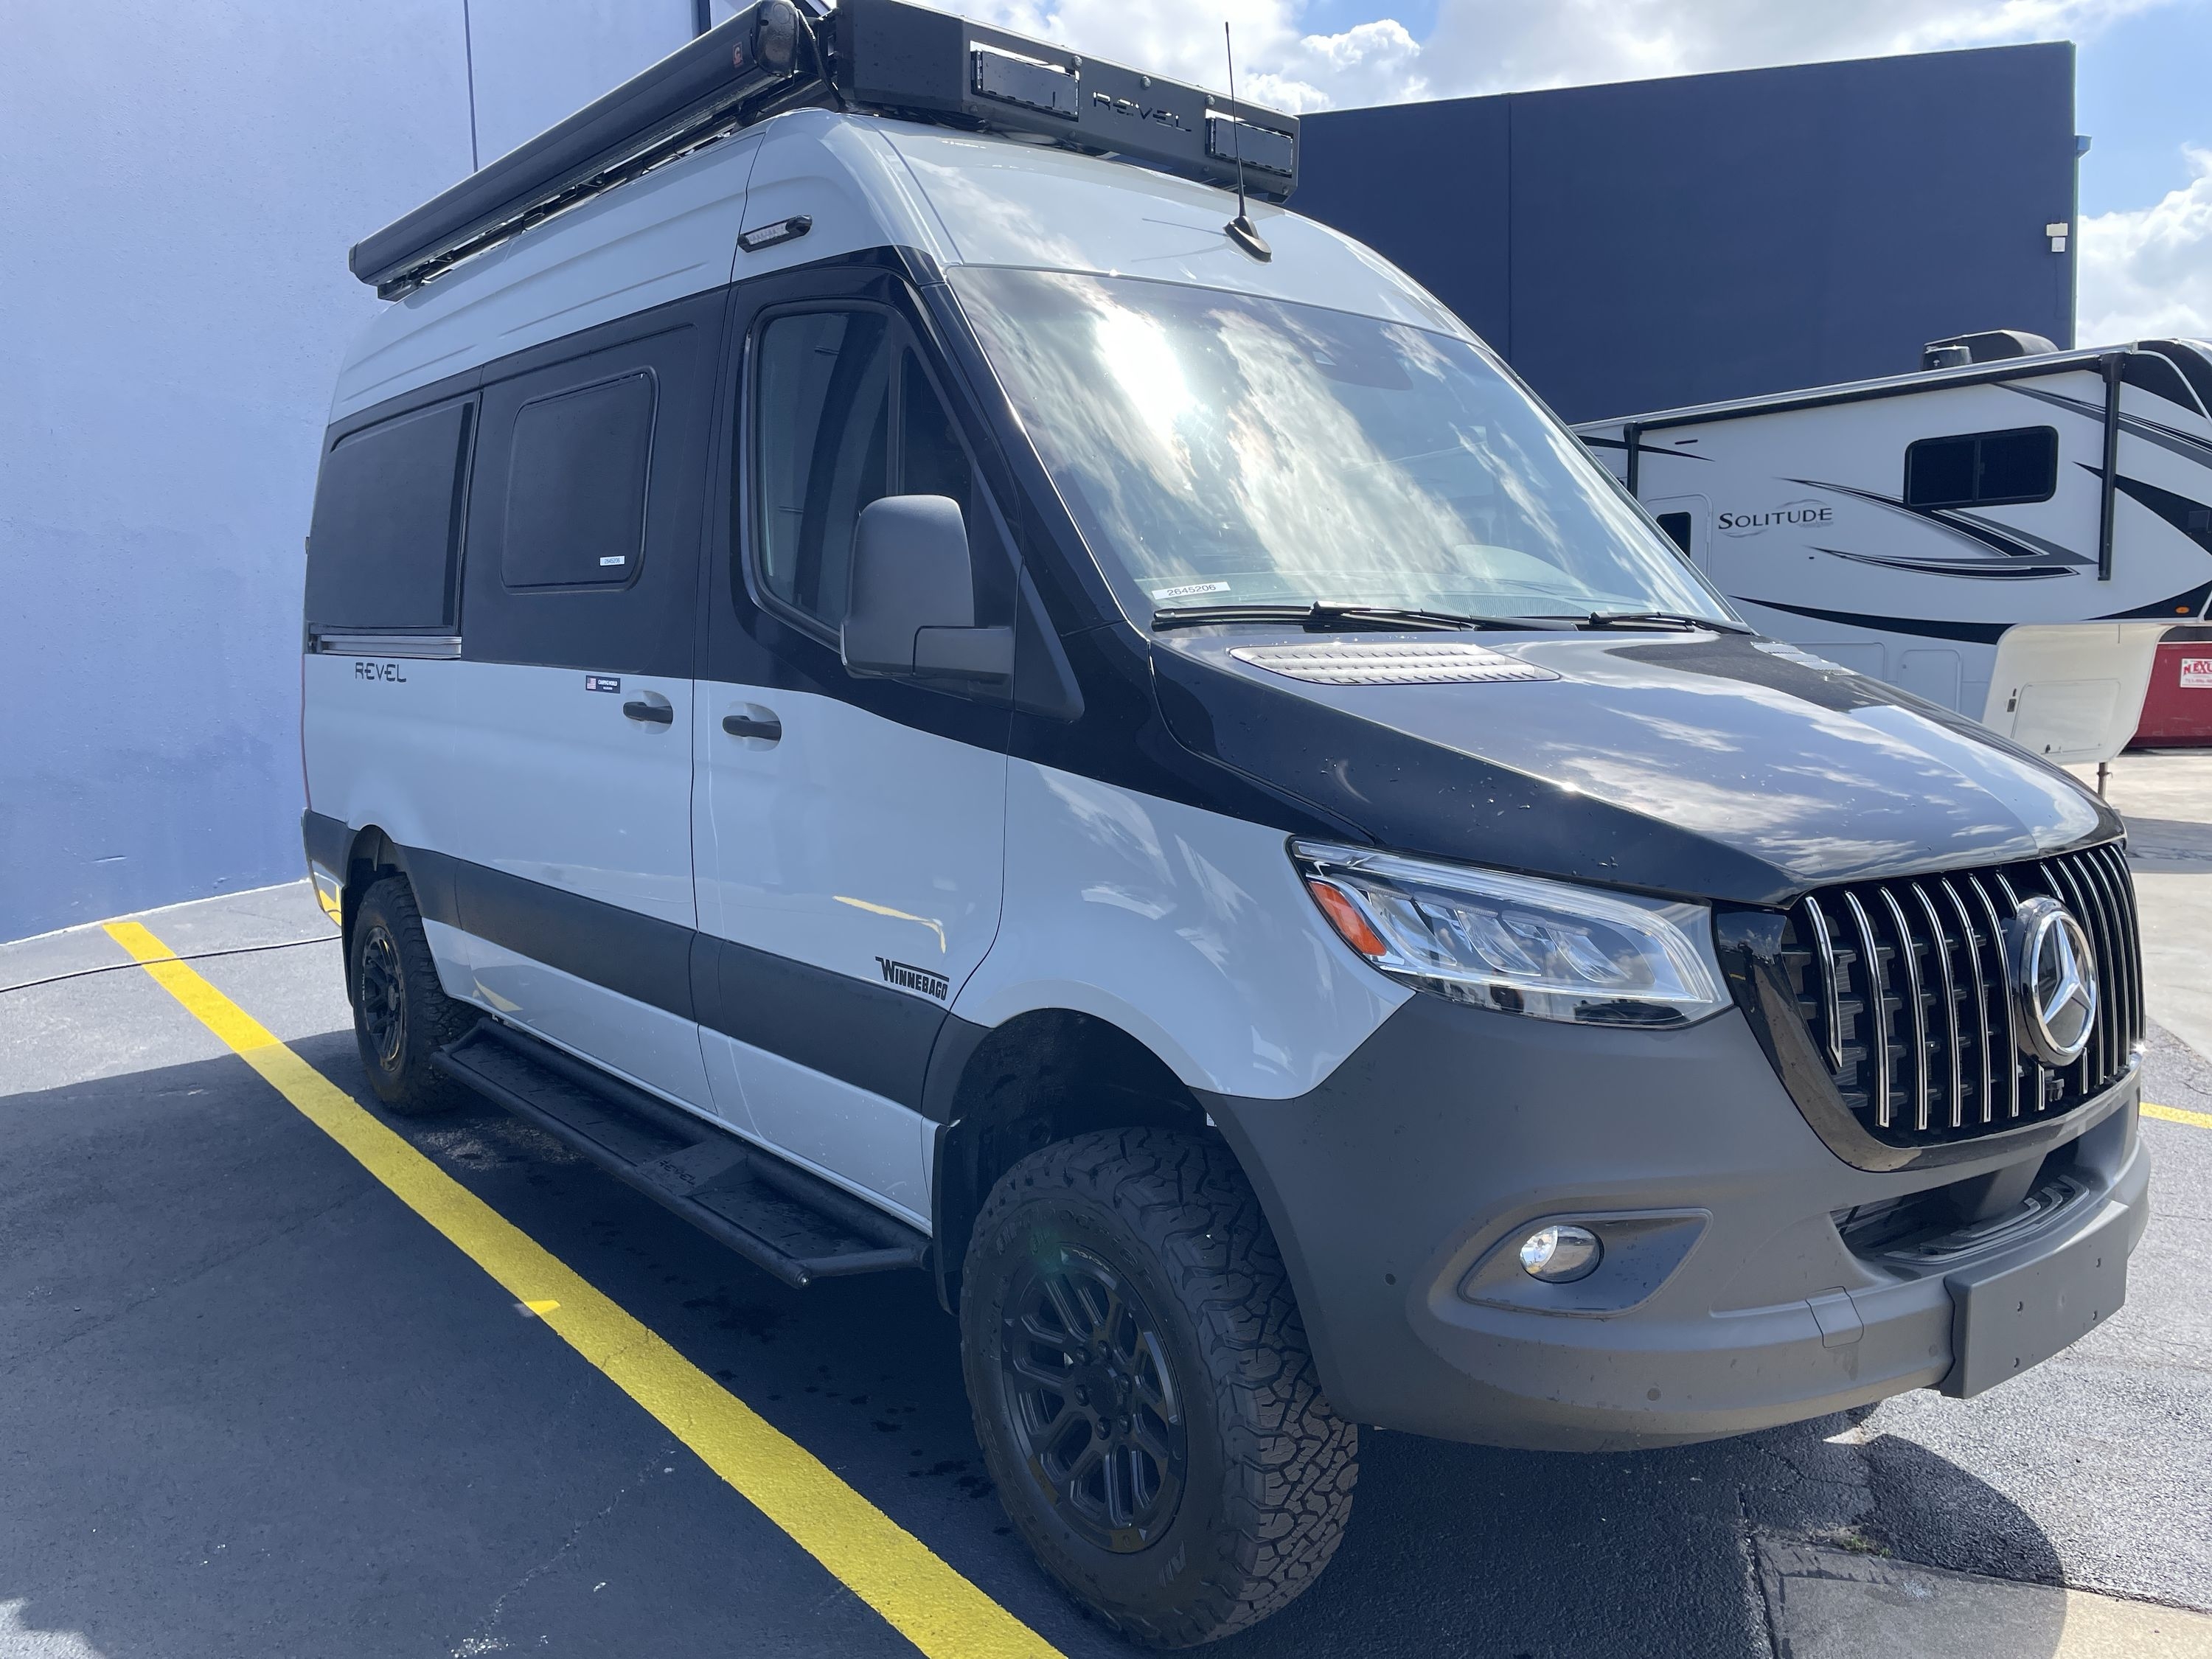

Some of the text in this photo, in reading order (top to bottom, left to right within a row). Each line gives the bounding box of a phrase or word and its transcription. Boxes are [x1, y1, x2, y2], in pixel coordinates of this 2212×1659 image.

[1093, 91, 1192, 132] REVEL
[1718, 507, 1833, 529] SOLITUDE
[1166, 584, 1217, 597] 2645206
[355, 662, 407, 683] REVEL
[874, 956, 950, 1001] WINNEBAGO
